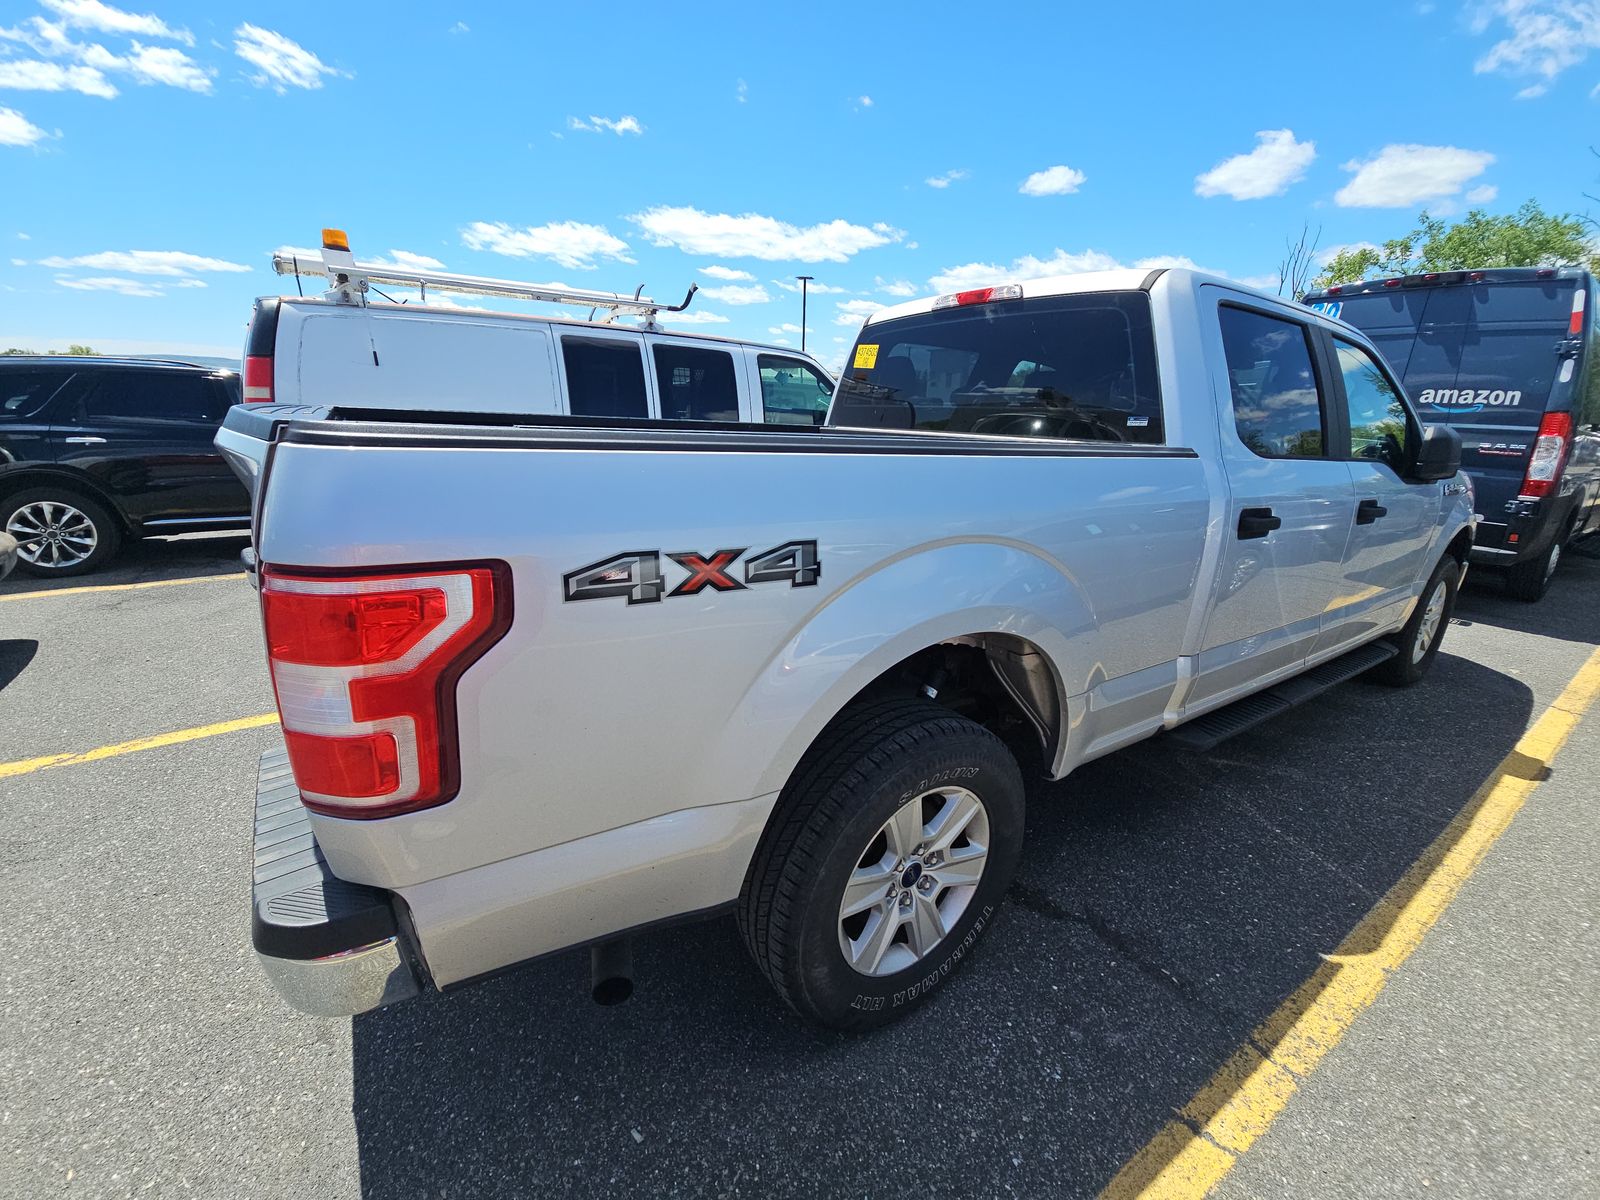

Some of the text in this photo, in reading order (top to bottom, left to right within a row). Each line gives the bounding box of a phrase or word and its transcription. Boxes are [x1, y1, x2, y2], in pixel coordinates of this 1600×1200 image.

[1419, 388, 1521, 406] amazon
[898, 767, 980, 806] SAILUN
[850, 905, 994, 1011] TERRAMAX HLT
